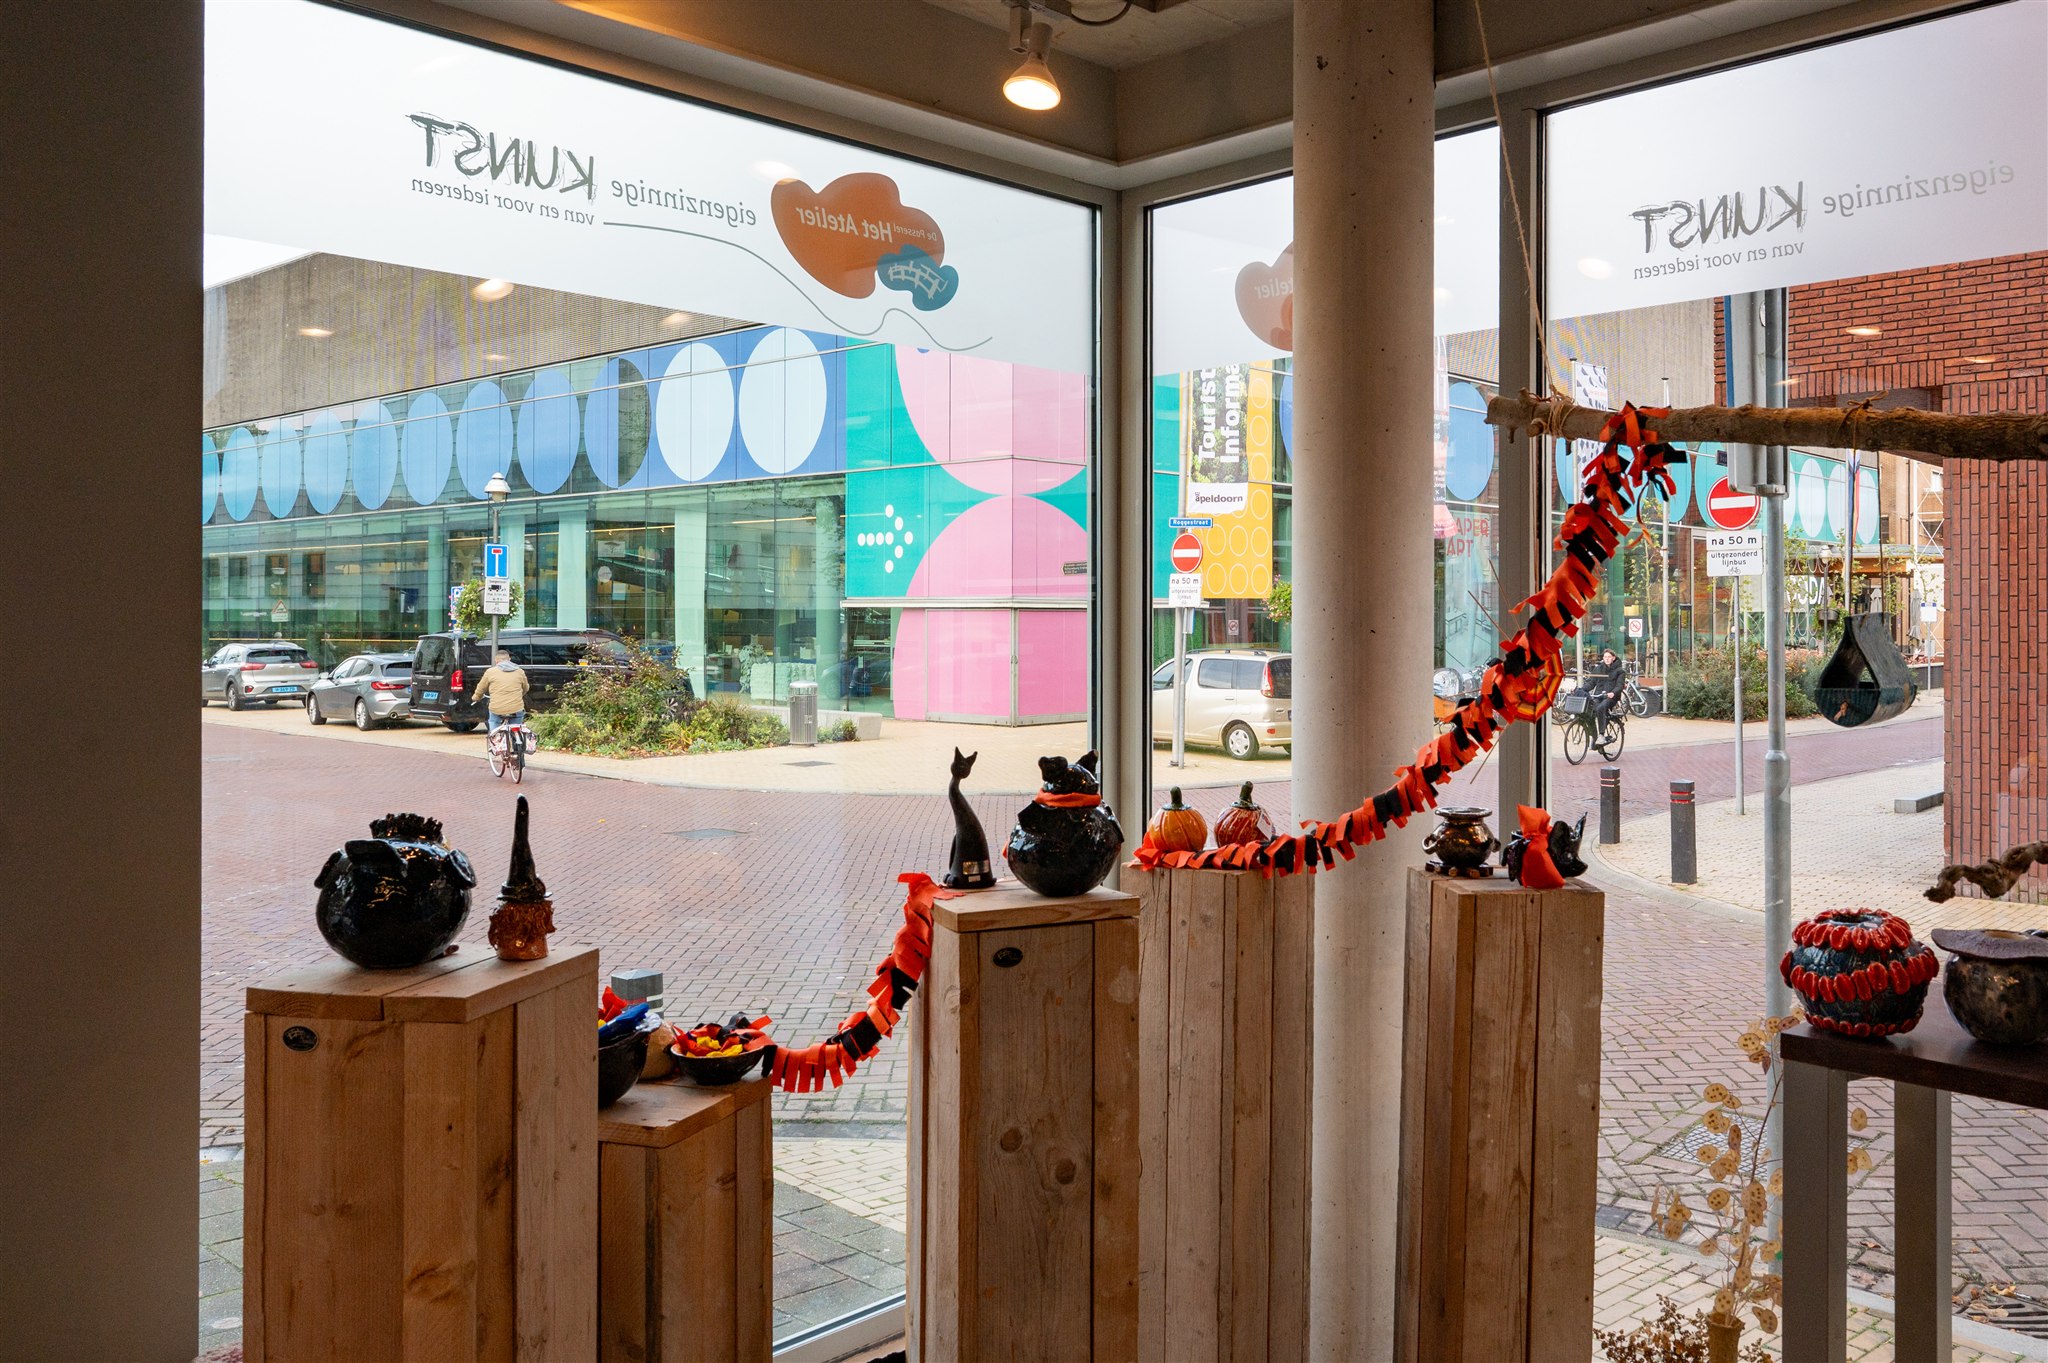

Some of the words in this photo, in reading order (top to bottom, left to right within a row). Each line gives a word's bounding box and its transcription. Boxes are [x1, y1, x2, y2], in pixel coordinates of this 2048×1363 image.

[1199, 368, 1216, 462] Tourist
[1456, 517, 1489, 537] APER
[1711, 538, 1725, 546] na
[1728, 535, 1743, 545] 50
[1711, 551, 1758, 559] uitgezonderd
[1722, 559, 1747, 567] lijnbus
[1181, 577, 1191, 585] 50
